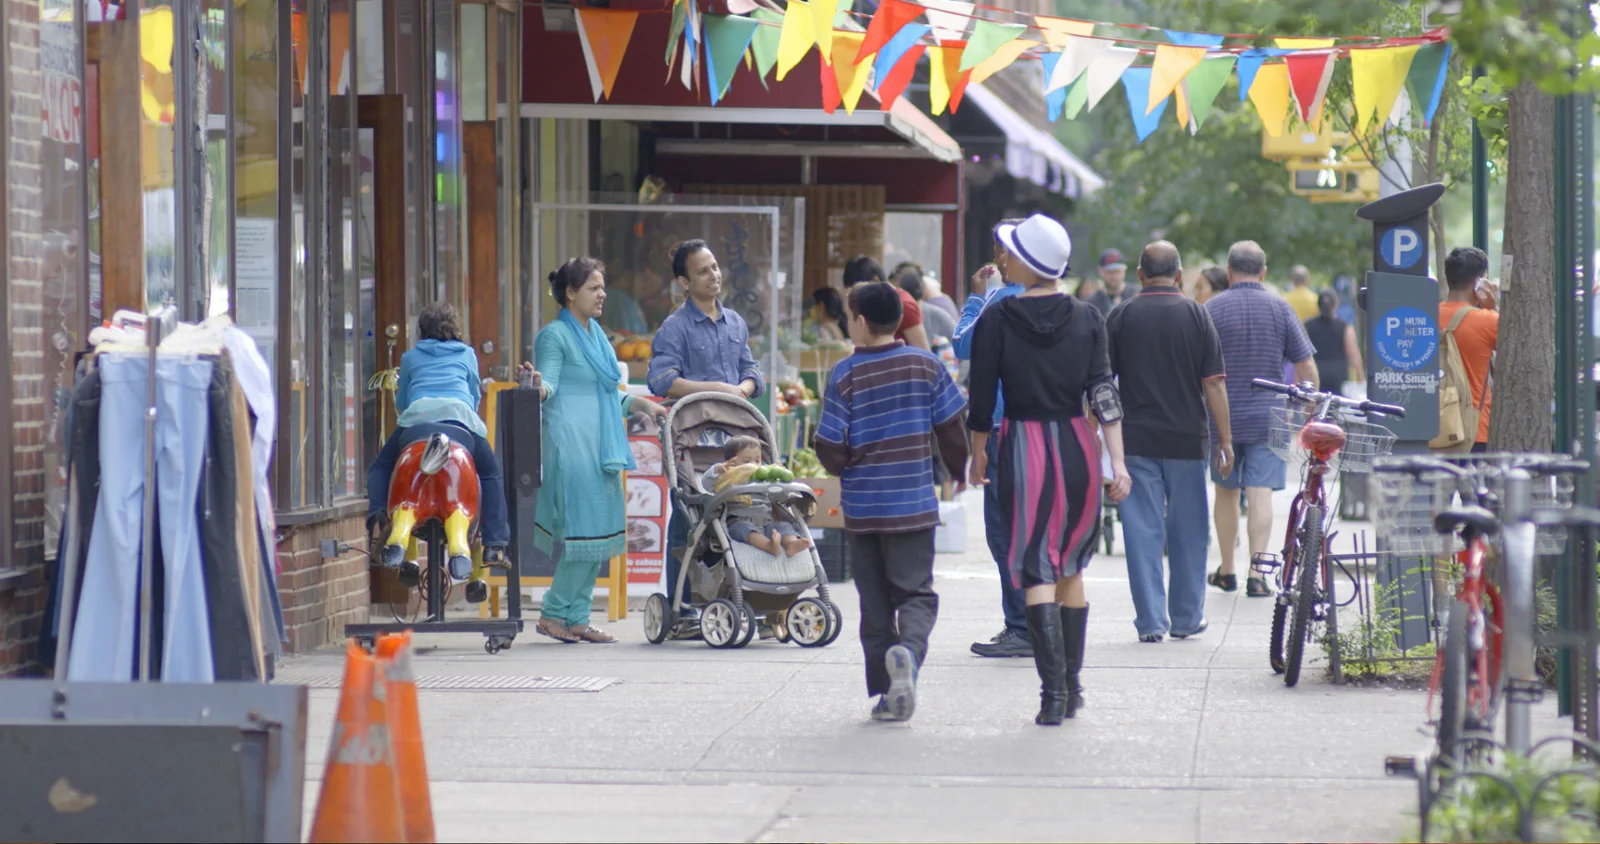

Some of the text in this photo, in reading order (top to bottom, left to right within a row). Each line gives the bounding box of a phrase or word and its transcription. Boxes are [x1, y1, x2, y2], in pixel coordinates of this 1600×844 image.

[1393, 229, 1418, 266] P
[1386, 316, 1400, 337] P
[1404, 317, 1427, 326] MUNI
[1404, 327, 1435, 337] METER
[1397, 339, 1414, 348] PAY
[1402, 349, 1410, 358] &
[1374, 372, 1436, 384] PARK Smart
